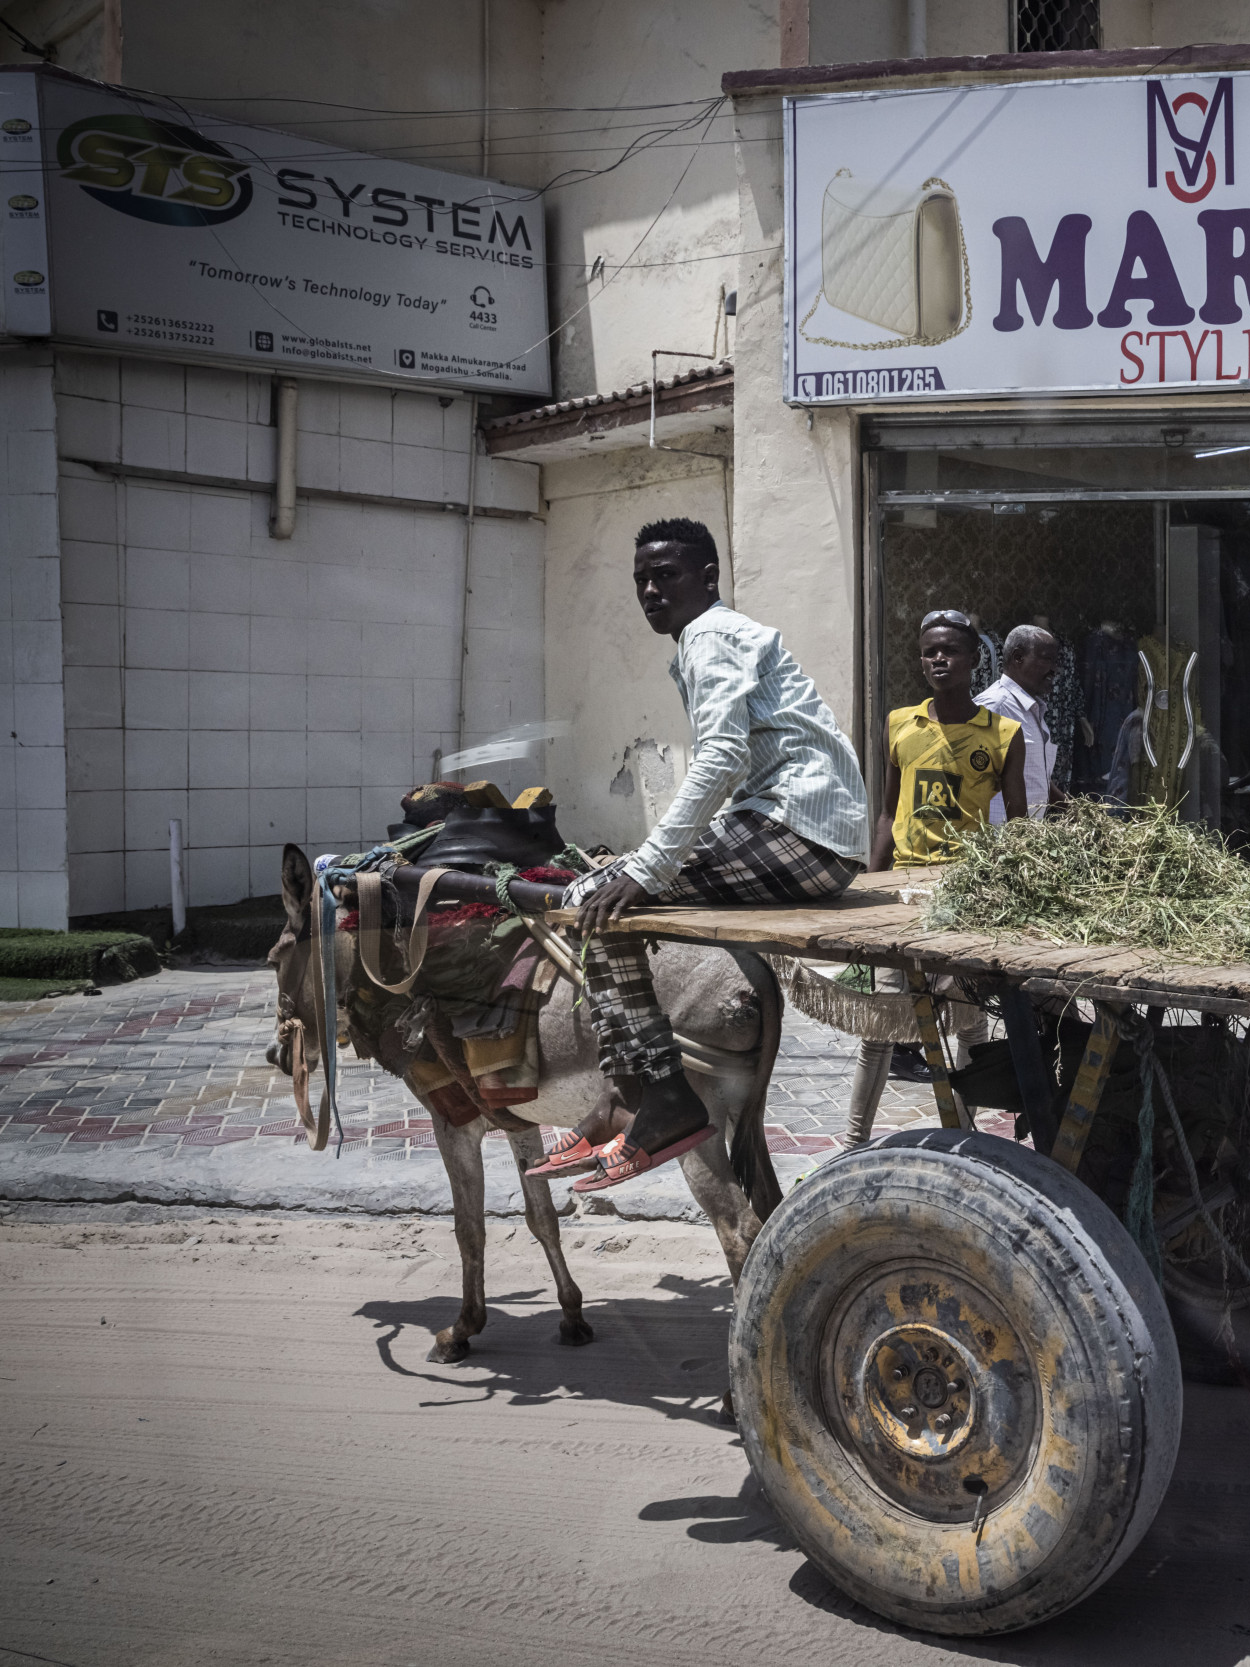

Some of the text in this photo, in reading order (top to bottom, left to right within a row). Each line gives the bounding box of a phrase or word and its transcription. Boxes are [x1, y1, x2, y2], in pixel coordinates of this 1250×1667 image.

[60, 134, 252, 207] STS
[277, 168, 532, 251] SYSTEM
[277, 211, 534, 269] TECHNOLOGY SERVICES
[302, 279, 391, 307] Technology
[126, 314, 215, 333] +252613652222
[469, 311, 498, 324] 4433
[469, 322, 497, 332] Call Center
[282, 333, 371, 352] www.globalsts.net
[421, 351, 449, 362] Makka
[451, 354, 503, 369] Almukarama
[421, 363, 469, 376] Mogadishu
[822, 368, 936, 396] 0610801265
